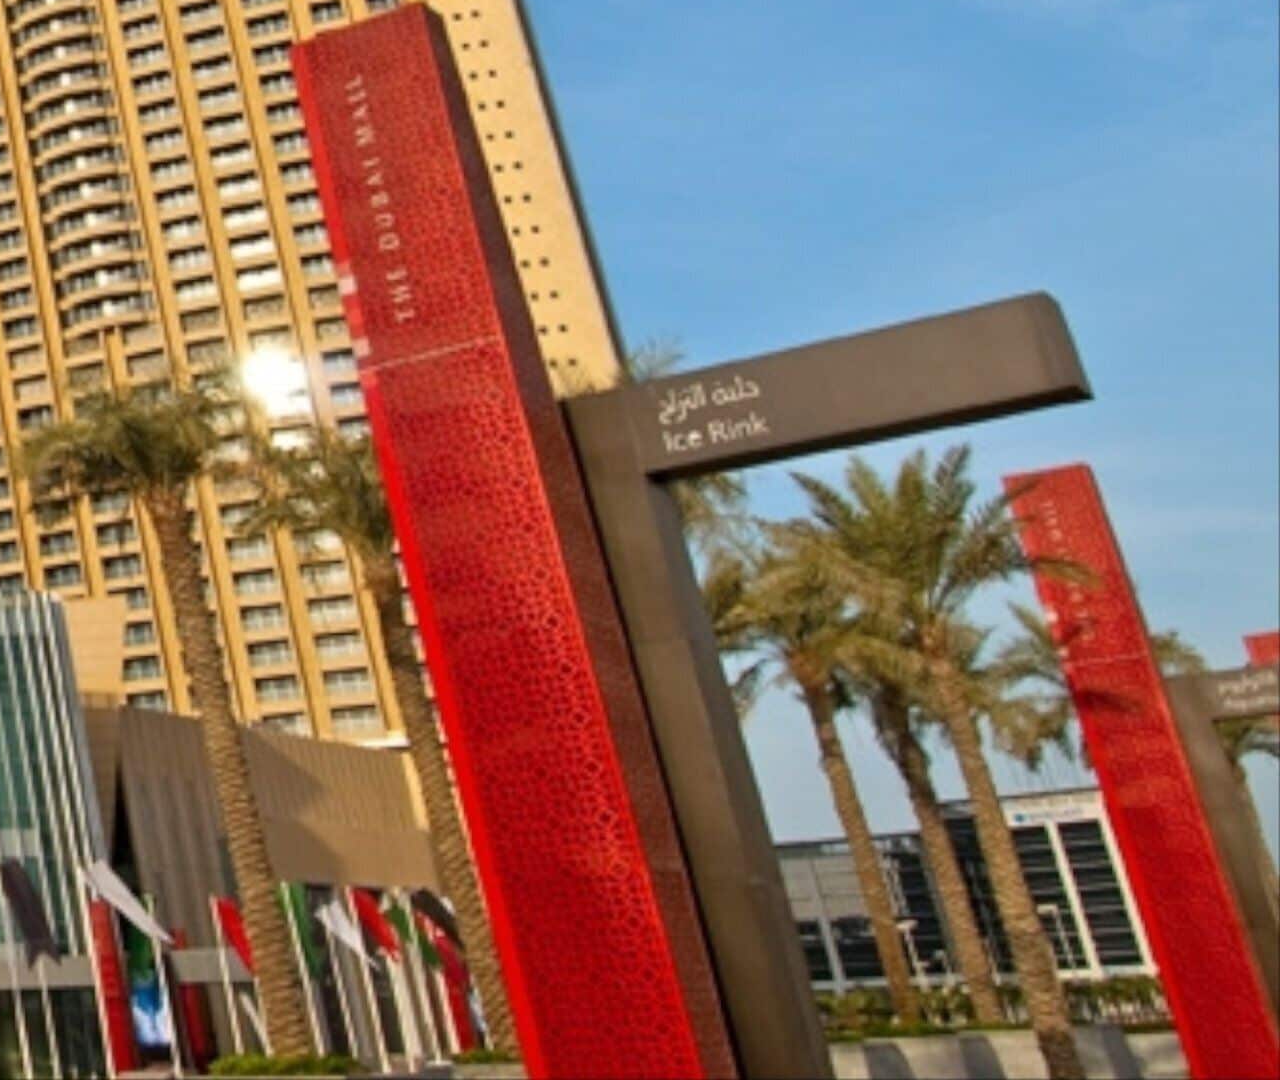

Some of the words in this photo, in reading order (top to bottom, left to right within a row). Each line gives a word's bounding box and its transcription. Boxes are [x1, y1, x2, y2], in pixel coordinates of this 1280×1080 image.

[344, 74, 376, 148] MALL
[361, 157, 400, 251] DUBAI
[385, 266, 416, 323] THE
[662, 431, 702, 454] Ice
[707, 411, 770, 443] Rink
